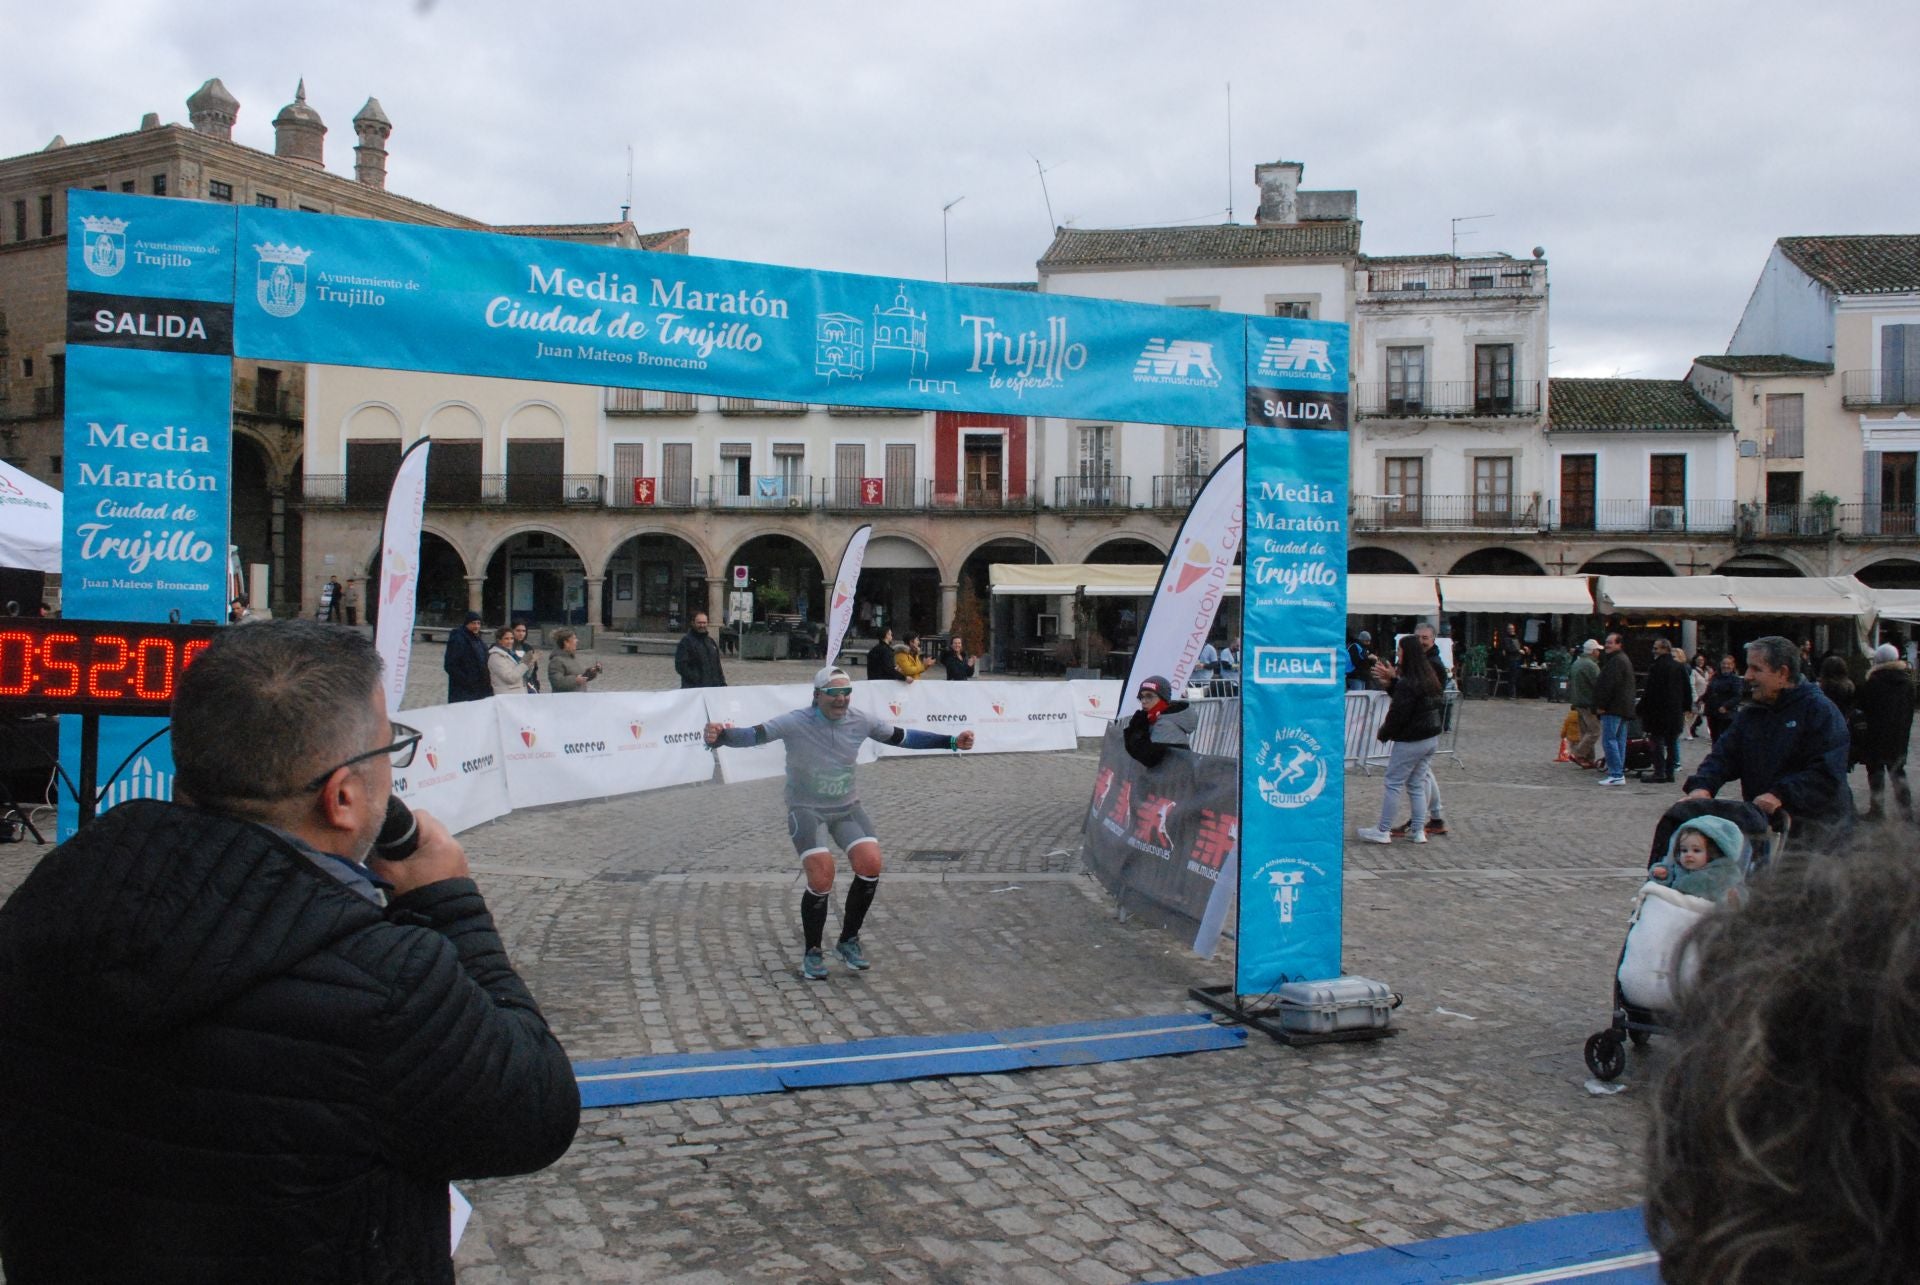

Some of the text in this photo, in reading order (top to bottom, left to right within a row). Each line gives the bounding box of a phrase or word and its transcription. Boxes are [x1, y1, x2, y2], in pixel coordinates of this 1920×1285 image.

[135, 239, 220, 255] Ayuntamiento de
[134, 251, 192, 269] Trujillo
[318, 271, 420, 291] Ayuntamiento de
[528, 264, 789, 319] Media Maratón
[316, 286, 385, 308] Trujillo
[94, 310, 207, 340] SALIDA
[485, 296, 763, 358] Ciudad de Trujillo
[536, 342, 708, 370] Juan Mateos Broncano
[961, 314, 1087, 381] Trujillo
[989, 368, 1004, 389] te
[1133, 373, 1219, 388] www.musicrun.es
[1257, 368, 1331, 380] www.musicrun.es
[1264, 400, 1332, 420] SALIDA
[87, 422, 210, 453] Media
[78, 463, 218, 491] Maratón
[1260, 482, 1334, 504] Media
[96, 499, 198, 521] Ciudad de
[1255, 511, 1341, 532] Maratón
[76, 523, 213, 574] Trujillo
[1264, 538, 1327, 555] Ciudad de
[82, 578, 209, 591] Juan Mateos Broncano
[1252, 556, 1337, 594] Trujillo
[1170, 583, 1221, 691] DIPUTACIÓN
[1211, 555, 1229, 581] DE
[0, 632, 212, 699] 0:52:0
[1265, 656, 1323, 674] HABLA
[1256, 727, 1321, 766] Club Atletismo
[1187, 860, 1219, 880] www.music
